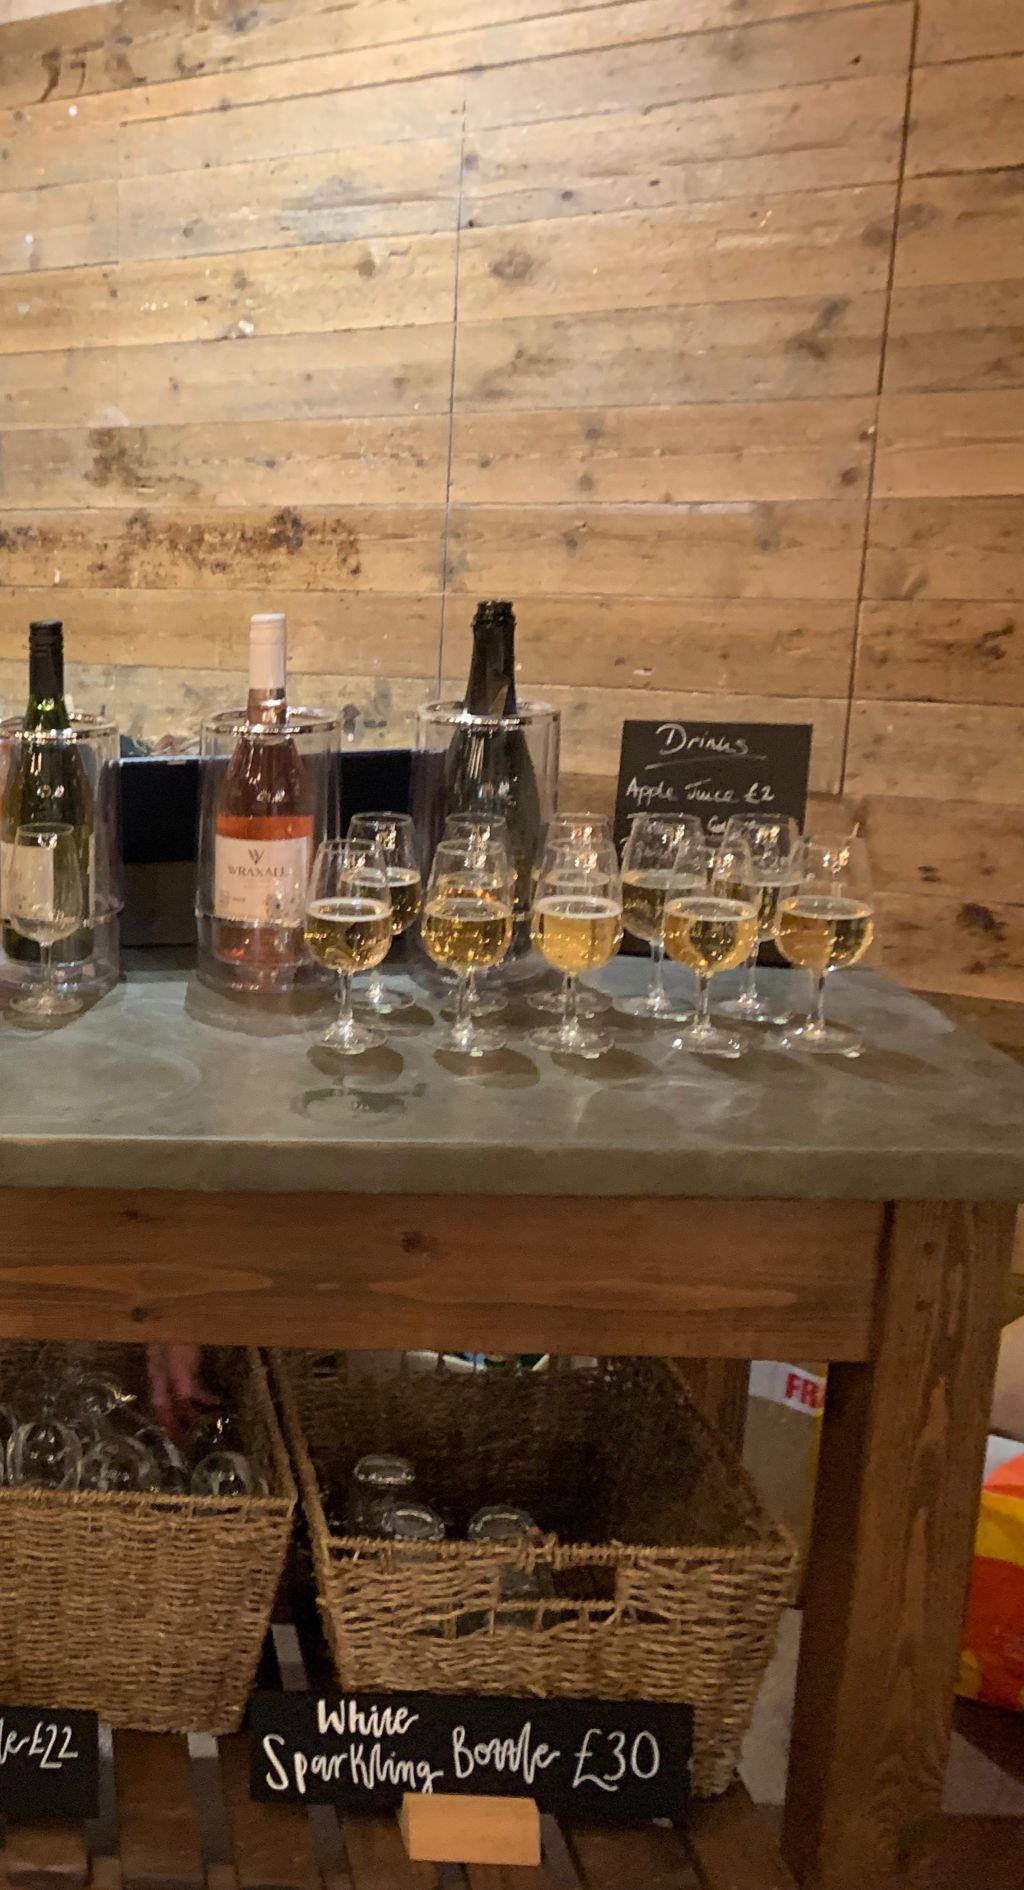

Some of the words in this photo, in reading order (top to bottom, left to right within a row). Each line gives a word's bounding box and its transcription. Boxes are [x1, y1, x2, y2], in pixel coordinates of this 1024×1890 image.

[656, 723, 749, 756] Drinks
[626, 777, 674, 806] Apple
[684, 778, 733, 803] Juice
[744, 782, 775, 804] £2
[316, 1699, 420, 1737] White
[28, 1720, 79, 1769] £22
[262, 1733, 444, 1795] Sparkling
[451, 1721, 562, 1784] Bottle
[572, 1728, 662, 1792] £30
